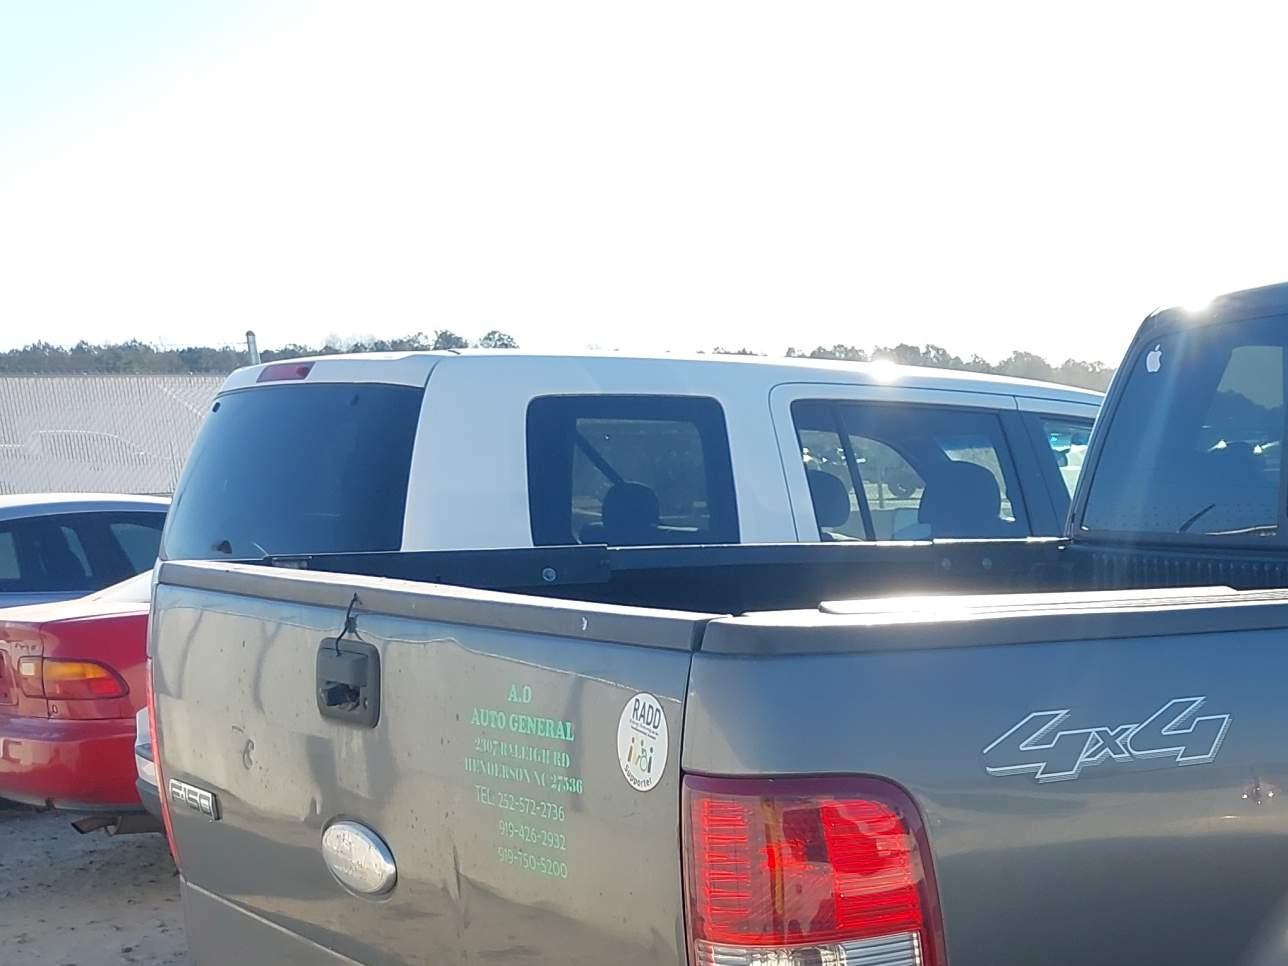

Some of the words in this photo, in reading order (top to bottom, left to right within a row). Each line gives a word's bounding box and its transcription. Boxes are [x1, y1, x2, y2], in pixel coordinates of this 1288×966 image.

[471, 707, 506, 729] AUTO
[509, 713, 575, 741] GENERAL
[632, 698, 661, 729] RADD
[500, 740, 550, 765] RALEIGH
[553, 751, 570, 768] RD
[982, 697, 1232, 783] 4x4
[464, 757, 531, 784] HENDERSON
[498, 791, 565, 822] 252-572-2736
[498, 820, 567, 851] 919-426-2932
[498, 847, 568, 879] 919-750-5200
